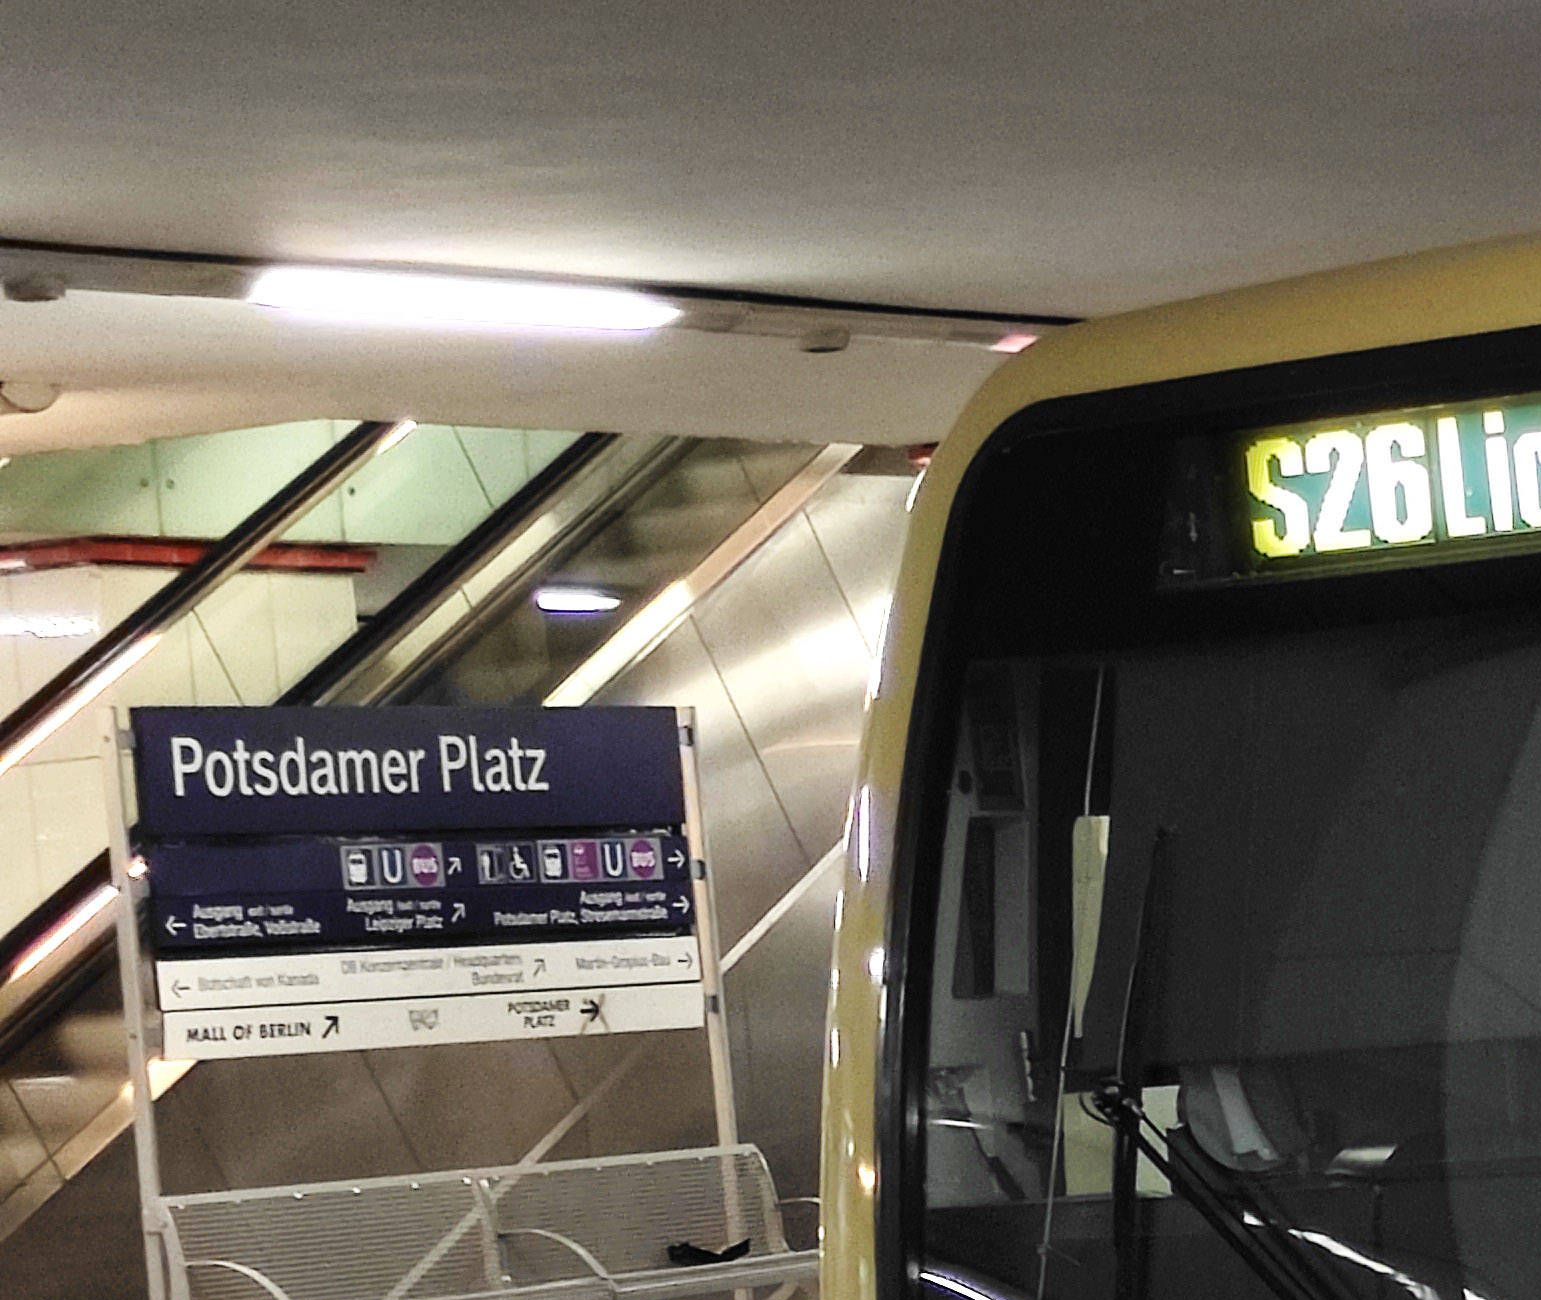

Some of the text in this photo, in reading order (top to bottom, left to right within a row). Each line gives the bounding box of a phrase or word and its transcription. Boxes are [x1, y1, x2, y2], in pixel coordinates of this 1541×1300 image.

[1244, 421, 1436, 560] S26
[172, 735, 549, 797] Potsdamer Platz
[383, 849, 401, 883] U
[603, 844, 623, 876] U
[187, 1022, 311, 1042] MALL OF BERLIN
